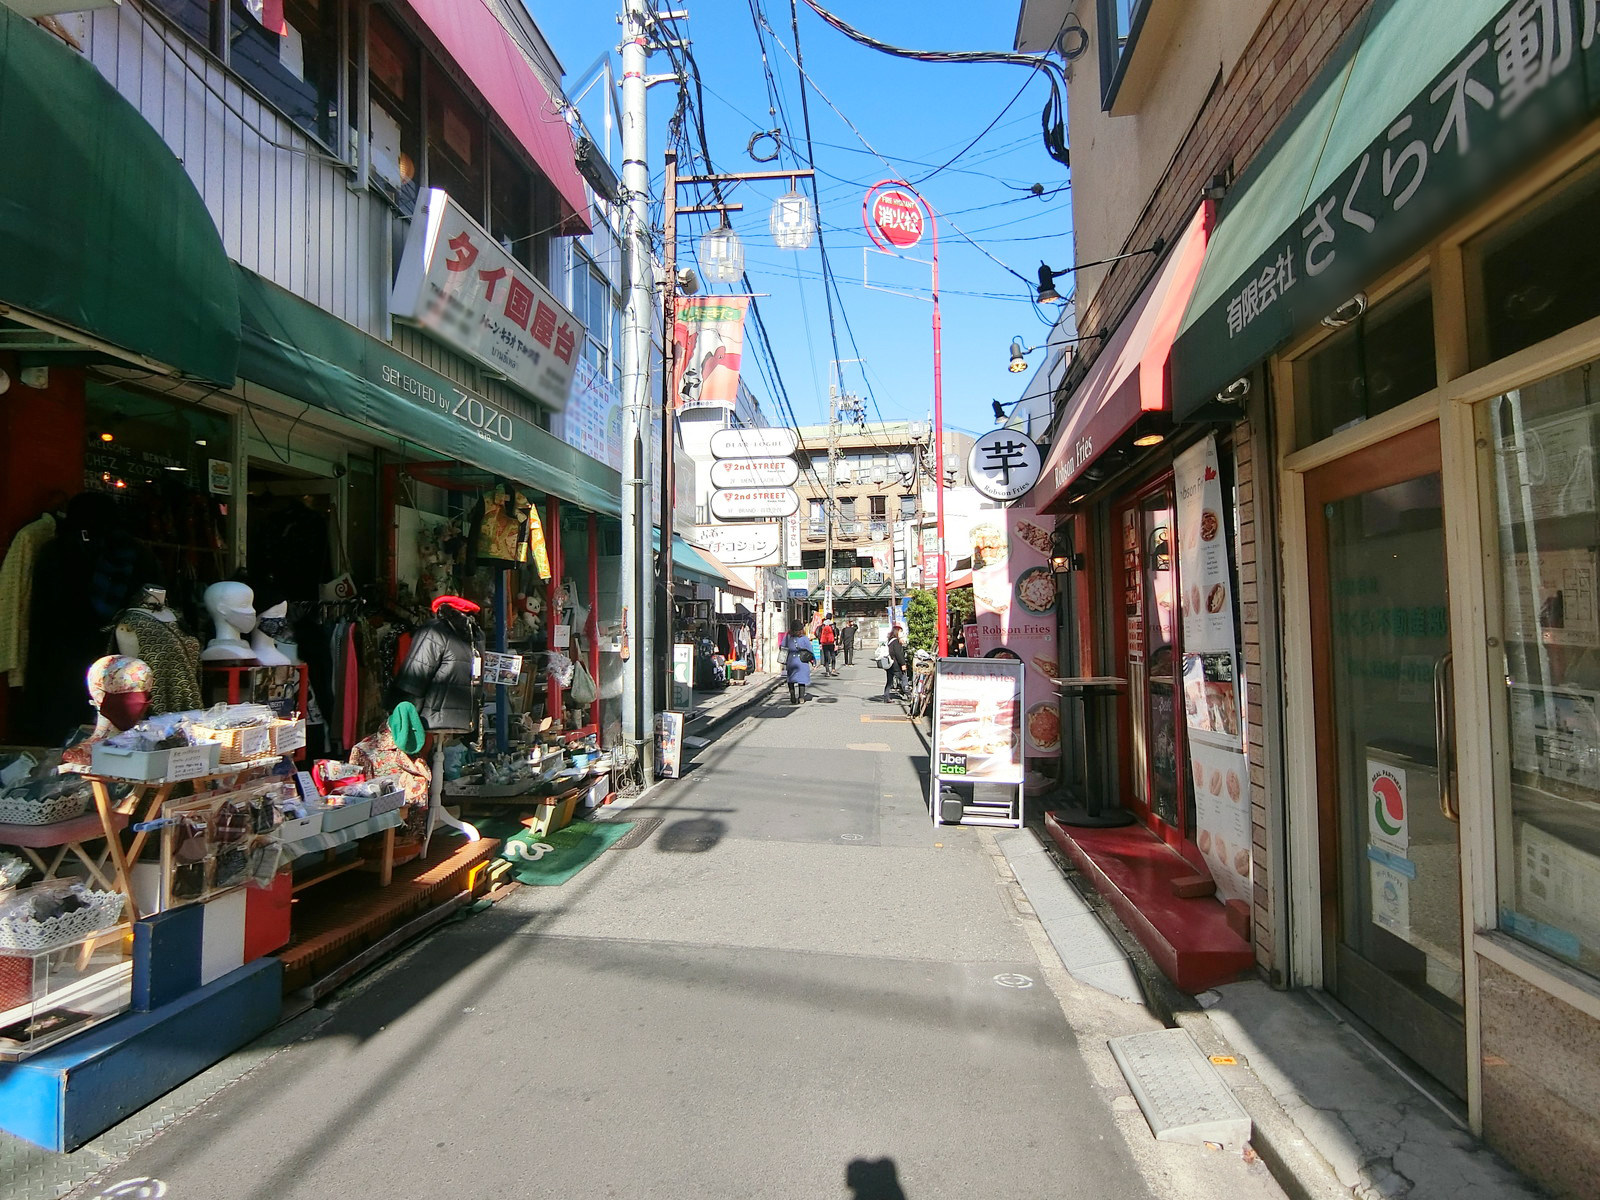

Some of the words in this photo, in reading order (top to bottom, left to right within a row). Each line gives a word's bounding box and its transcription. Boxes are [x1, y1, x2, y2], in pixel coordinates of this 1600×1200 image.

[881, 196, 893, 204] FIRE
[878, 205, 919, 233] 消火栓
[446, 231, 575, 365] タイ国屋台
[1226, 245, 1297, 338] 有限会社
[382, 365, 436, 404] SELECTED
[439, 392, 450, 413] by
[452, 387, 513, 442] ZOZO
[734, 463, 751, 471] 2nd
[753, 462, 786, 470] STREET
[981, 441, 1029, 486] 芋
[1054, 456, 1075, 489] Robson
[1075, 435, 1093, 468] Fries
[983, 484, 1012, 496] Robson
[1012, 481, 1030, 496] Fries
[734, 493, 751, 501] 2nd
[753, 492, 786, 500] STREET
[982, 625, 1021, 635] Robson
[1024, 624, 1051, 634] Fries
[940, 753, 966, 765] Uber
[940, 764, 966, 775] Eats
